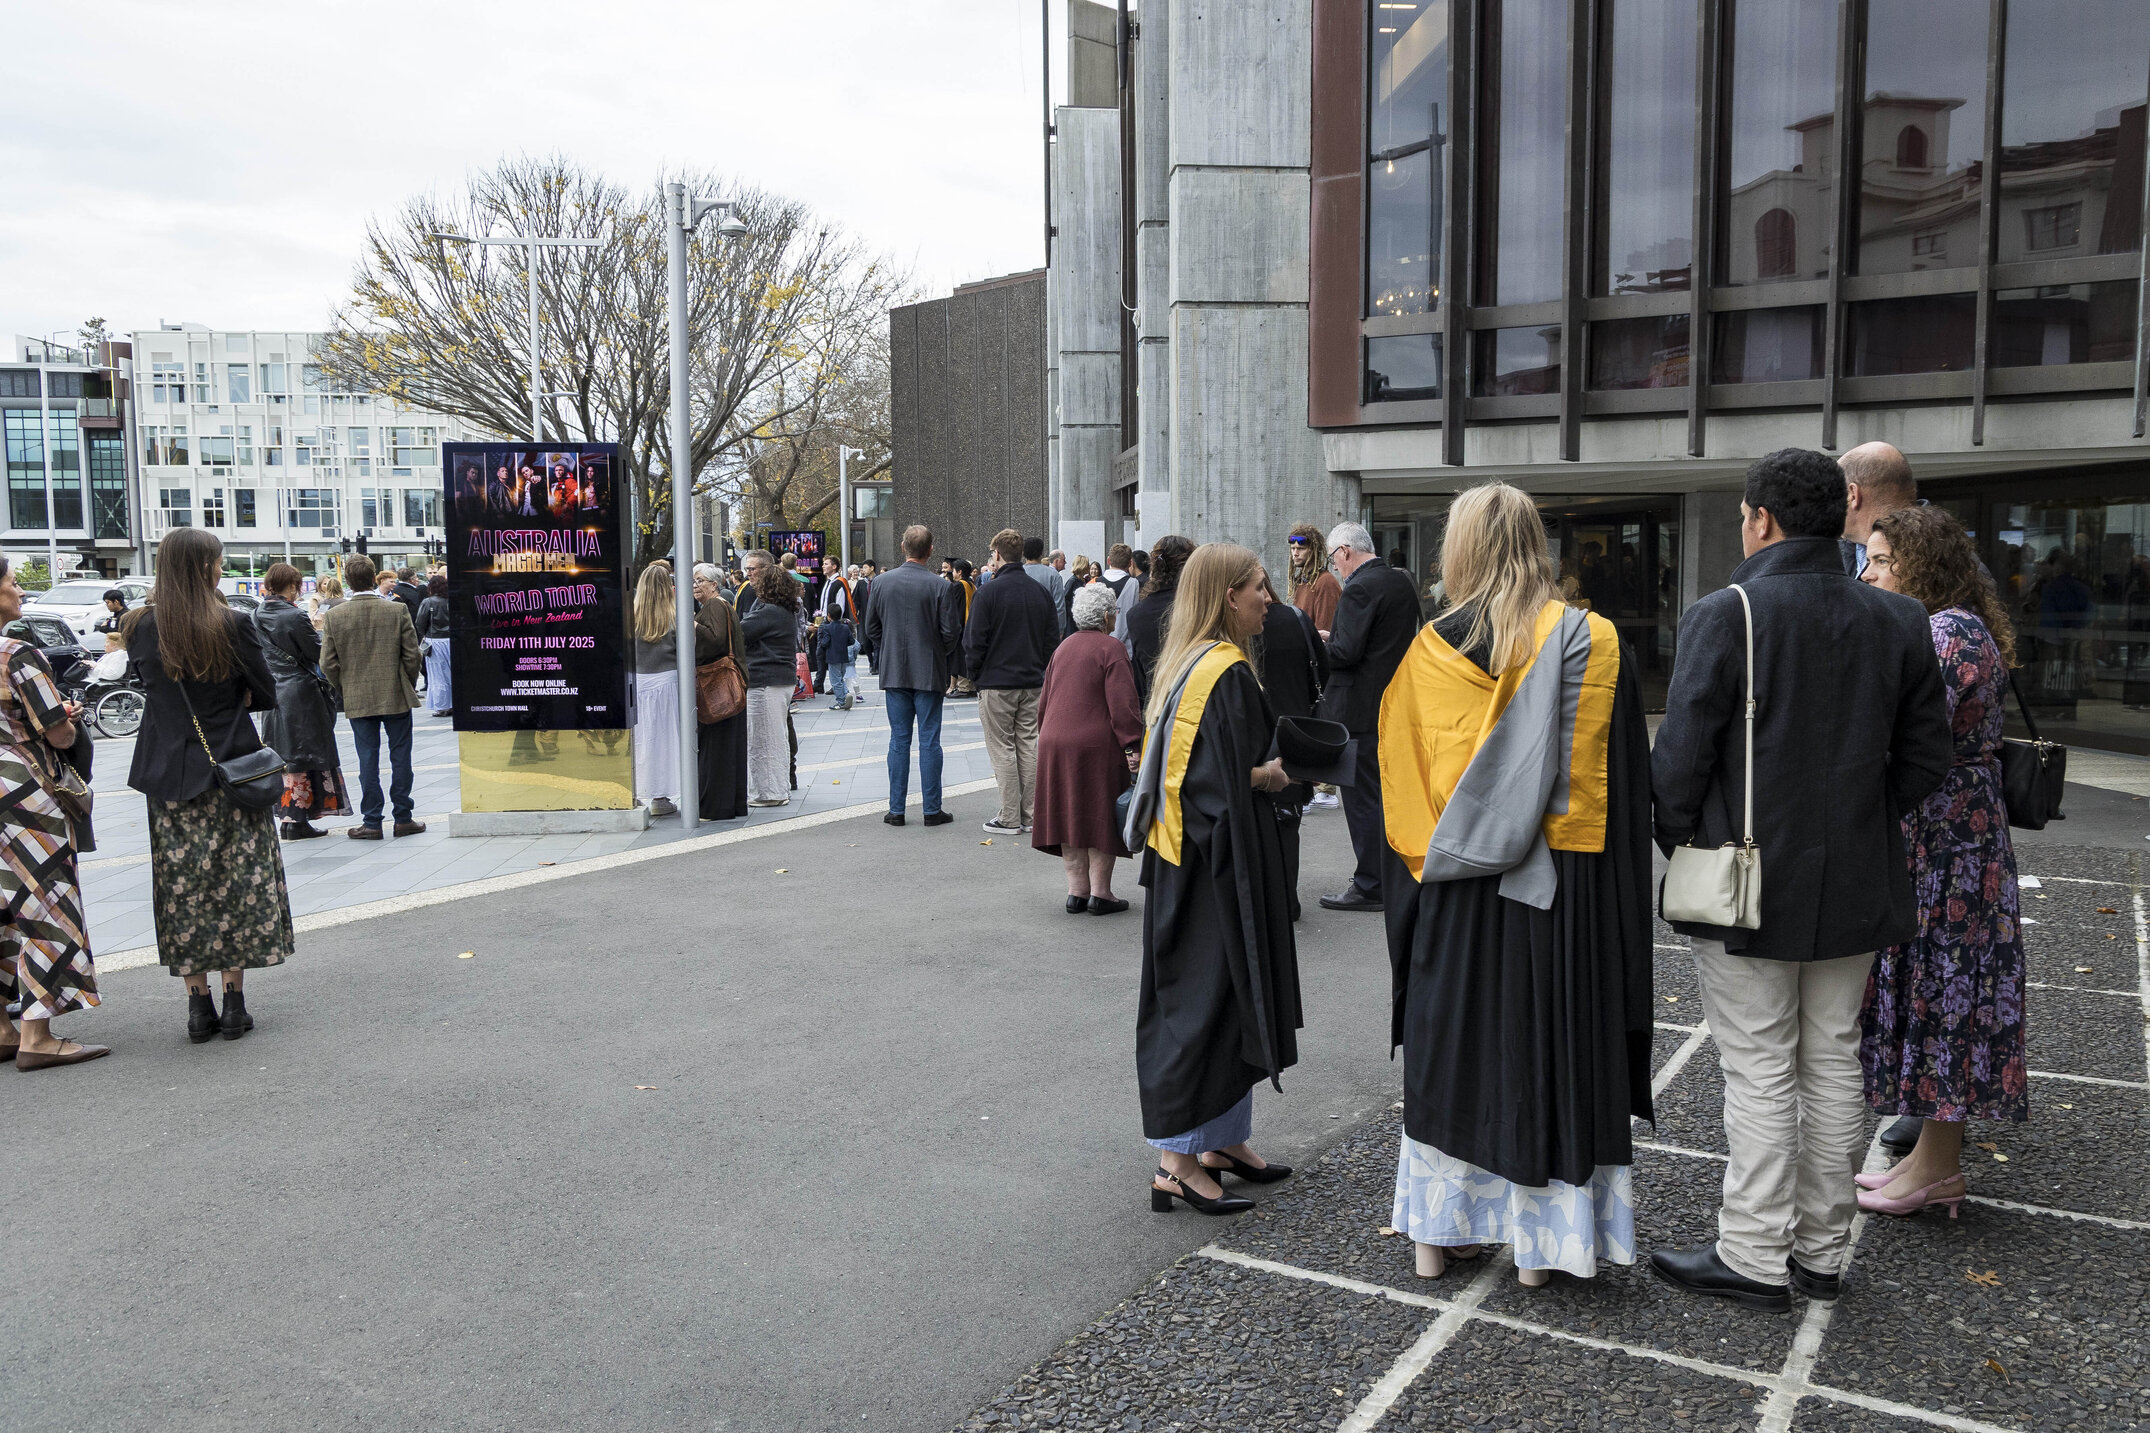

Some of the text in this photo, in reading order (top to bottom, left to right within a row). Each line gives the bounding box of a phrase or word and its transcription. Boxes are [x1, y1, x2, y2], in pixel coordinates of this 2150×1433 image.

[468, 529, 601, 557] AUSTRALIA
[544, 552, 576, 572] MEN
[474, 584, 598, 615] WORLD TOUR
[491, 610, 583, 629] Live in New Zealand
[480, 636, 595, 649] FRIDAY 11TH JULY 2025
[515, 663, 543, 671] SHOWTIME
[500, 687, 579, 696] WWW.TICKETMASTER.CO.NZ
[512, 679, 567, 688] BOOK NOW ONLINE
